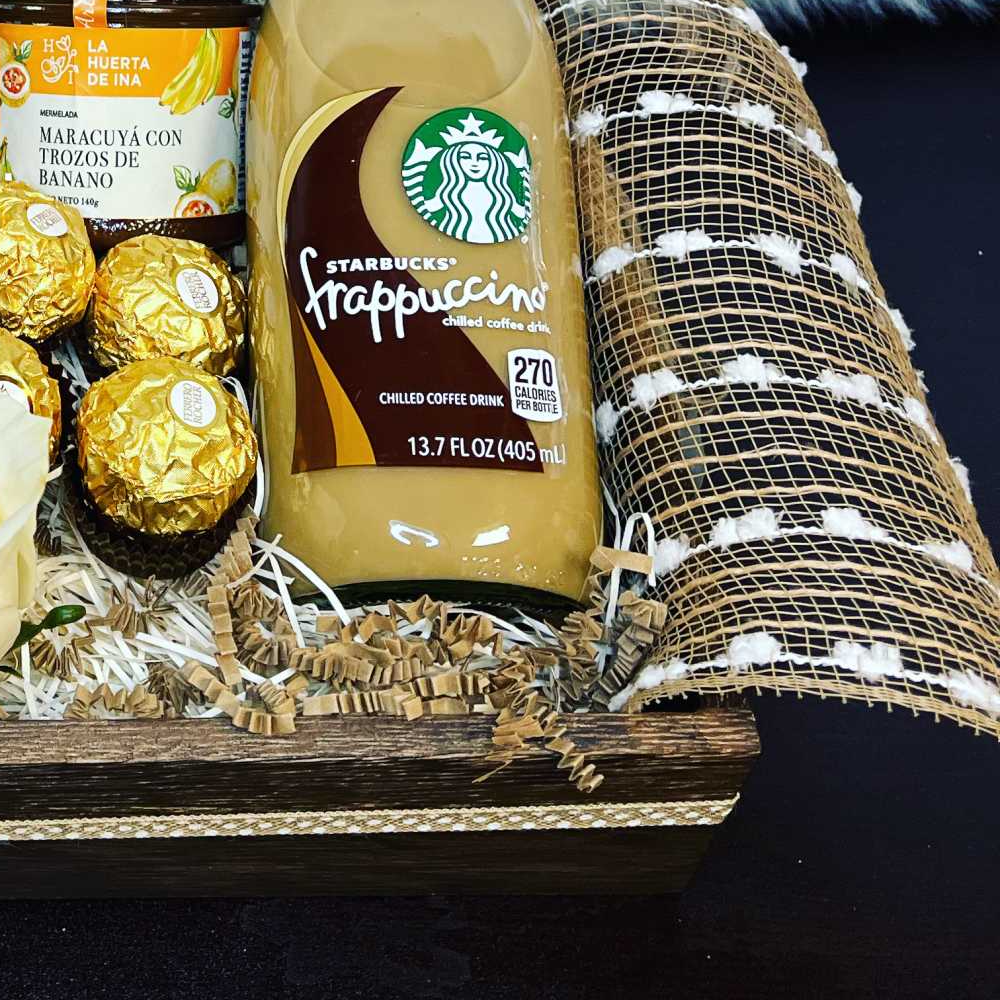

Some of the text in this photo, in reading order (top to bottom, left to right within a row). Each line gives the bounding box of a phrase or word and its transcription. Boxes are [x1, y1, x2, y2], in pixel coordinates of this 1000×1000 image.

[87, 39, 109, 53] LA
[87, 56, 151, 70] HUERTA
[87, 72, 142, 87] DE INA
[40, 109, 78, 119] MERMELADA
[39, 124, 182, 147] MARACUYÁ CON
[39, 147, 140, 168] TROZOS DE
[39, 168, 113, 189] BANANO
[58, 195, 80, 206] NETO
[81, 197, 100, 209] 140g
[442, 315, 484, 328] chilled
[486, 317, 525, 331] coffee
[514, 356, 553, 387] 270
[379, 392, 505, 407] CHILLED COFFEE DRINK
[514, 386, 557, 403] CALORIES
[516, 399, 531, 410] PER
[407, 436, 566, 465] 13.7 FL OZ (405 mL)
